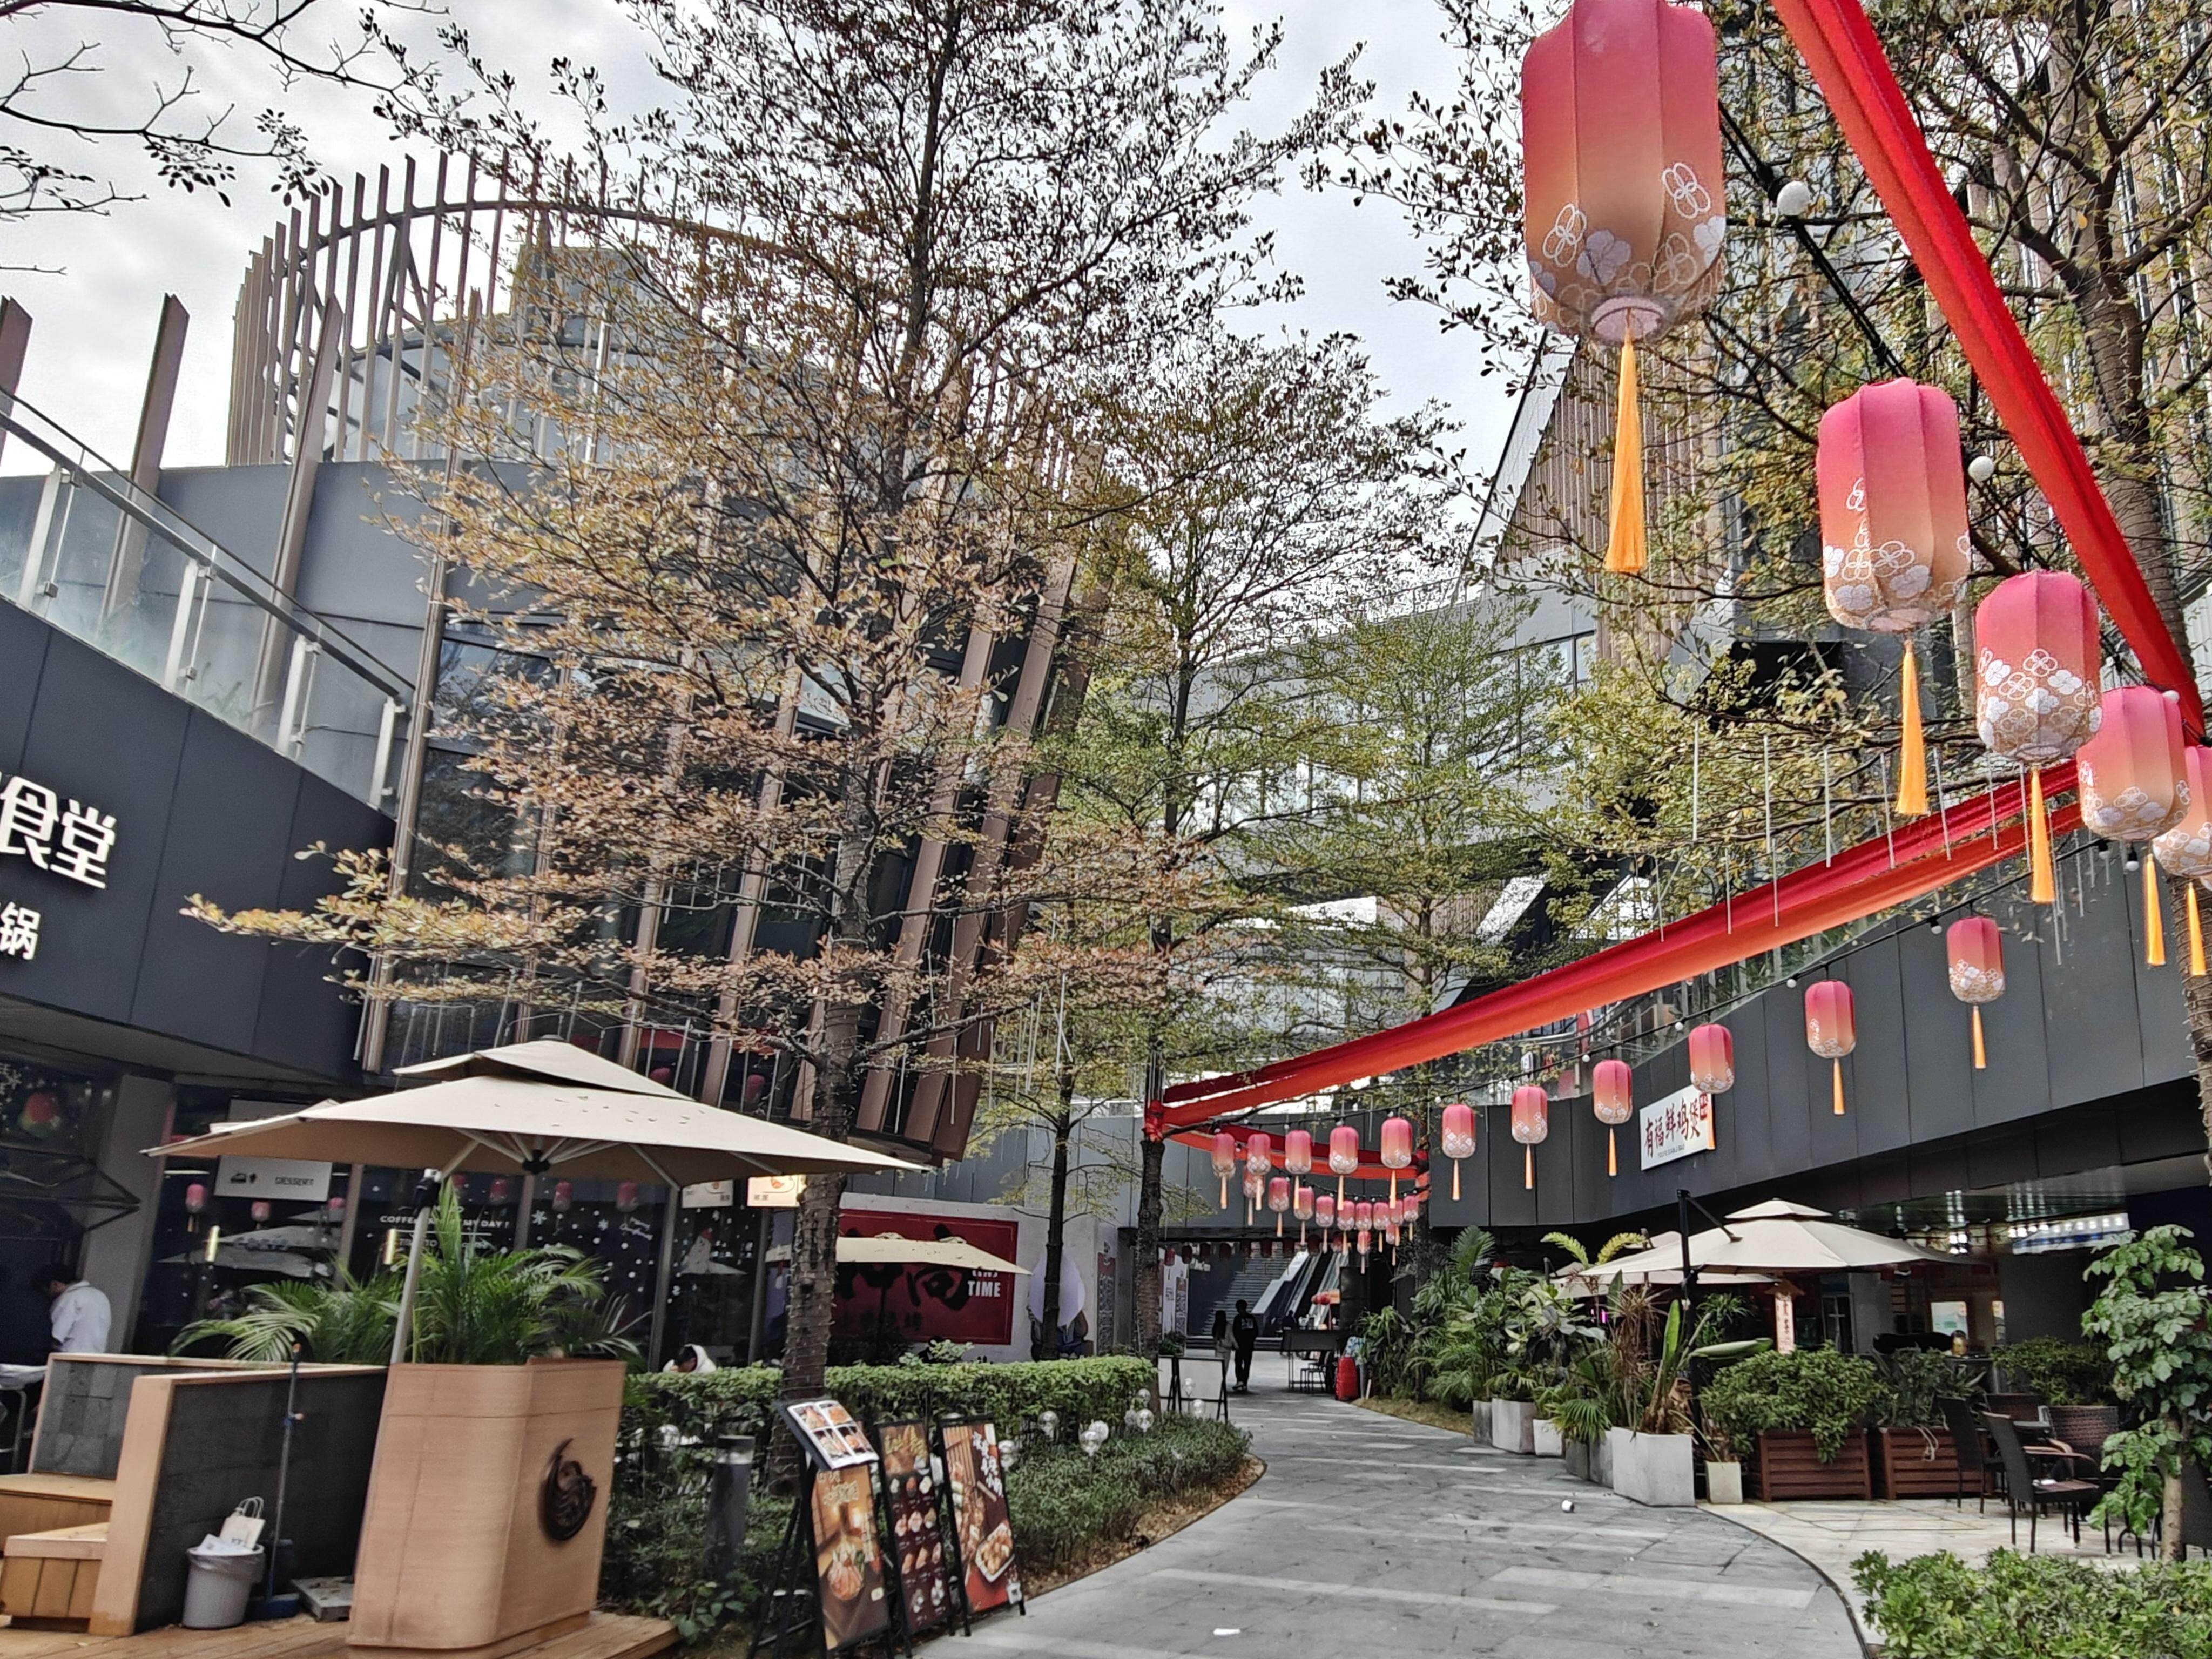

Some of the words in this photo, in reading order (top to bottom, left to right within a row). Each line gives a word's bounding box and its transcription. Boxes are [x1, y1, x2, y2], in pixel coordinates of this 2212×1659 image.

[0, 776, 117, 889] 食堂
[380, 1215, 417, 1224] COFFE
[967, 1280, 1001, 1297] TIME
